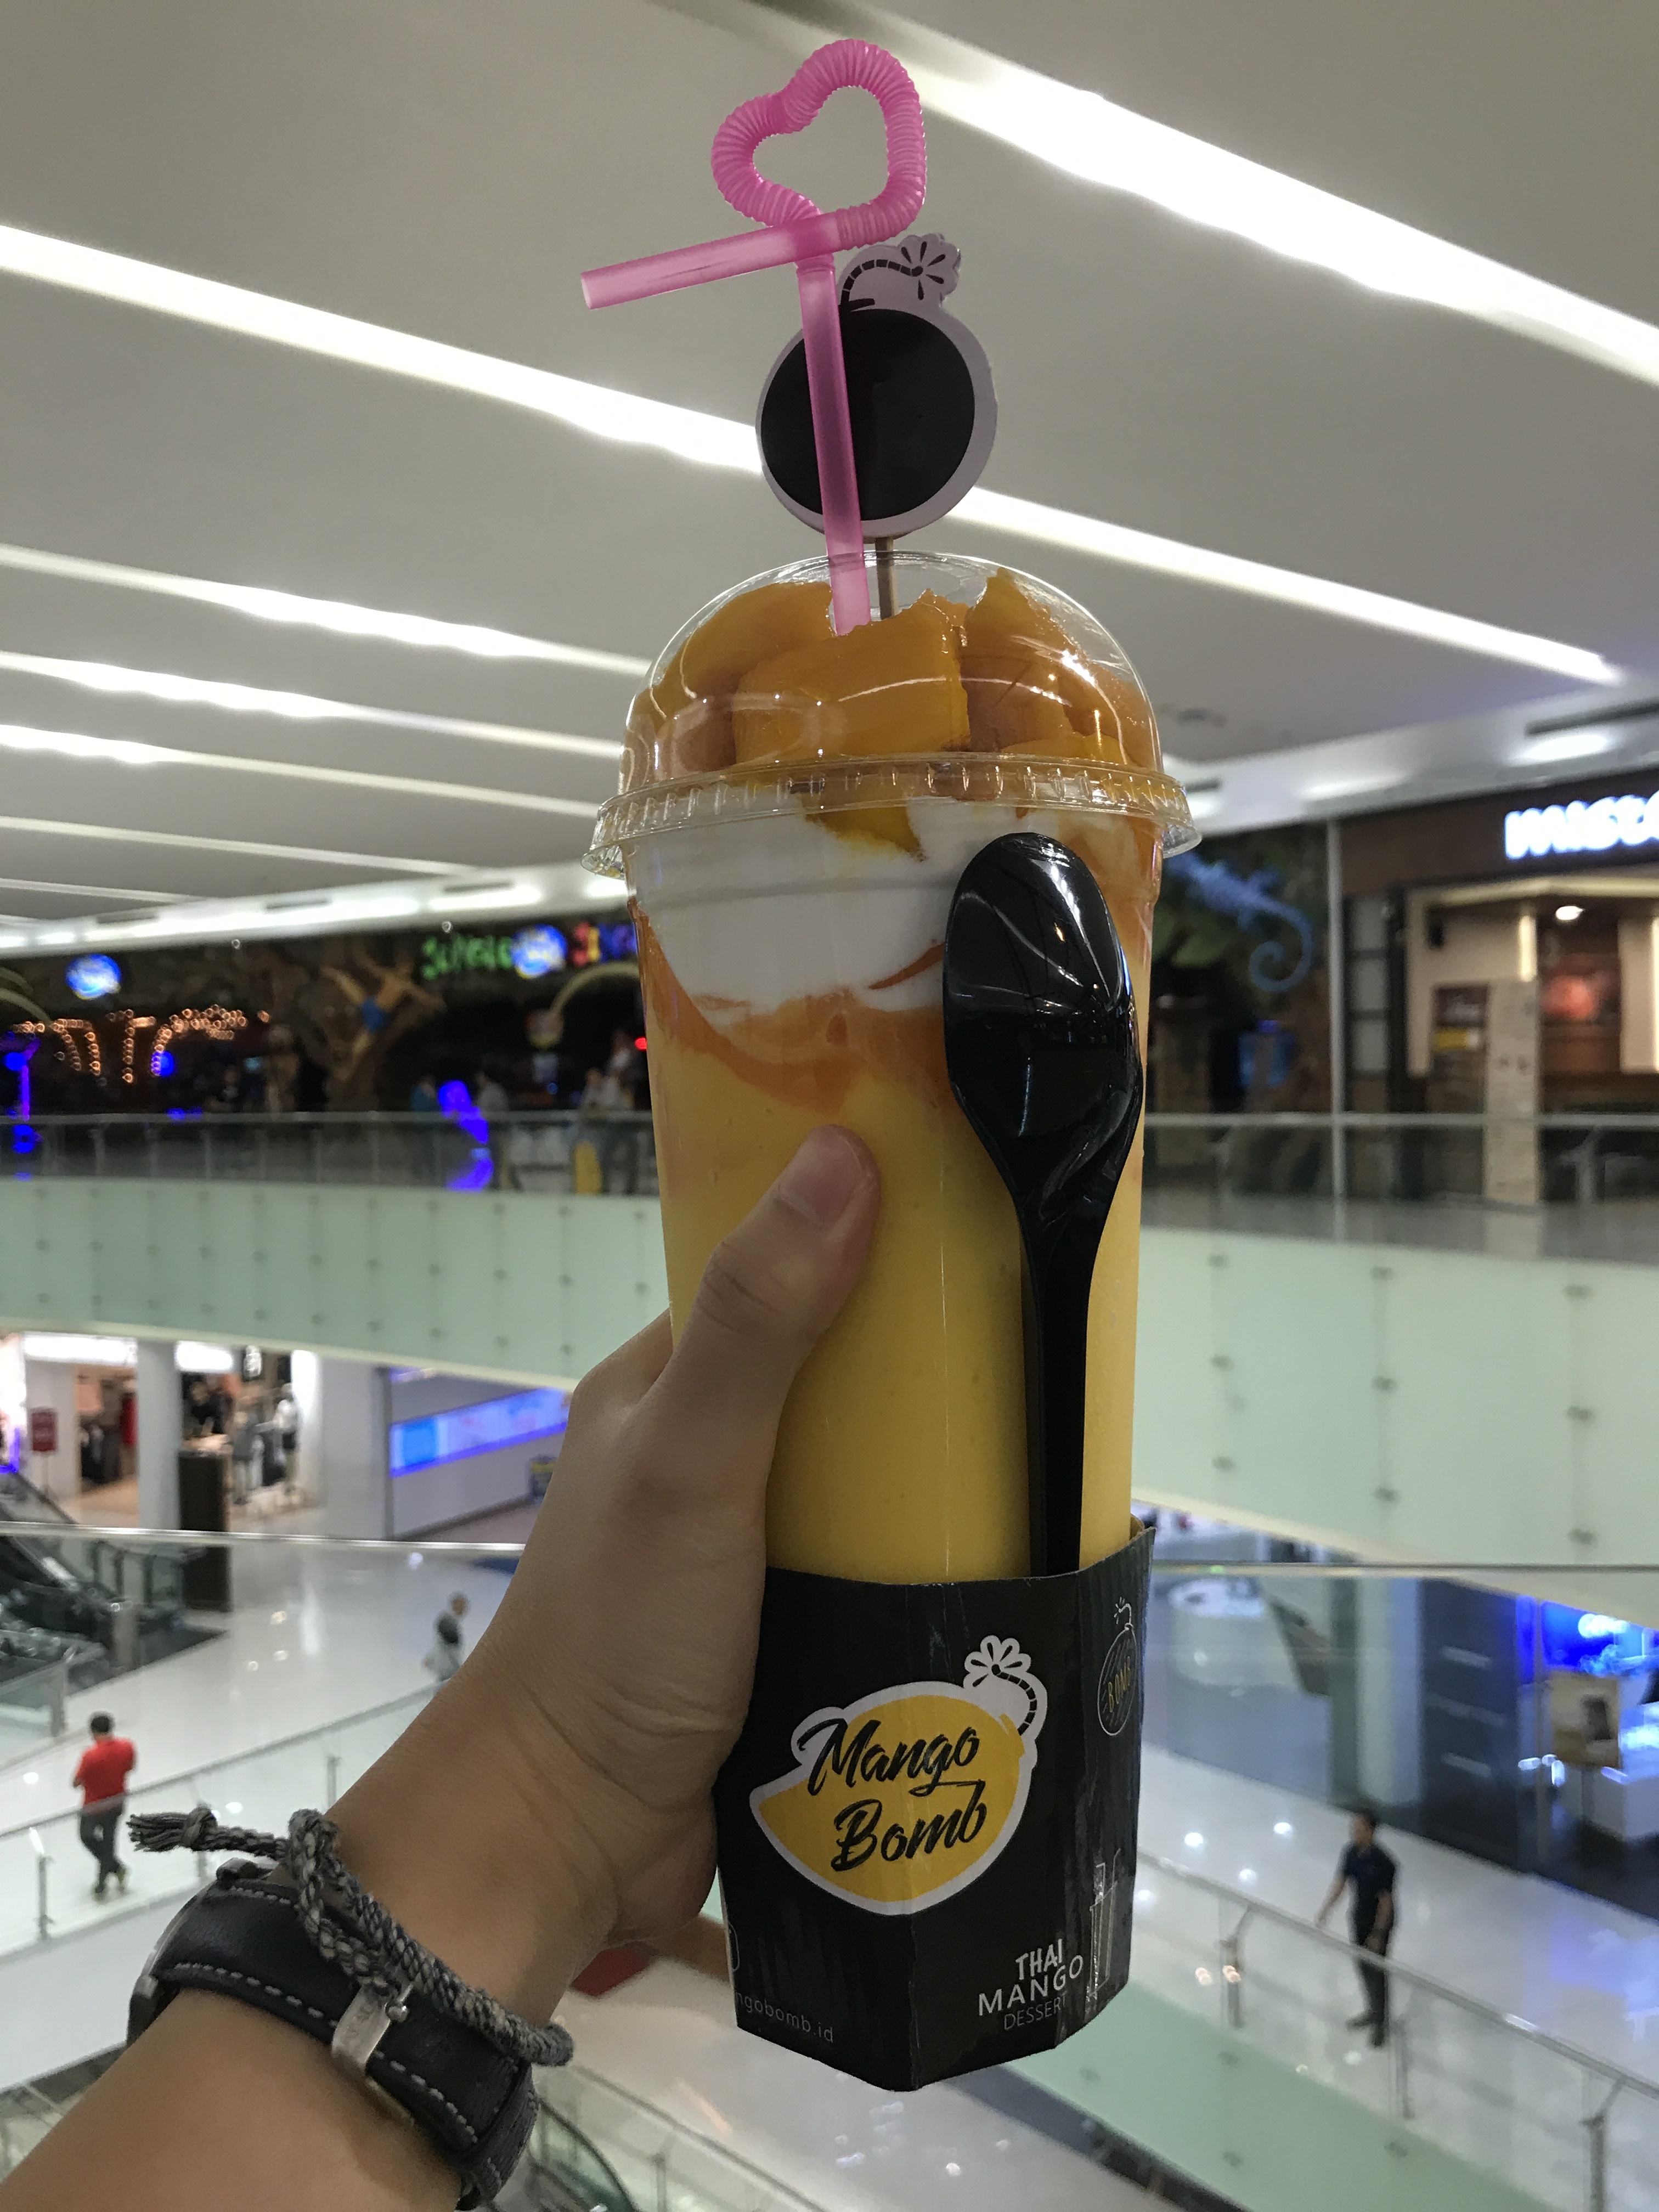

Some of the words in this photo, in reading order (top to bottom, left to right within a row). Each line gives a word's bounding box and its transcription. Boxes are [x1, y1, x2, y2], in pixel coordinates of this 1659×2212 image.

[797, 1718, 980, 1797] Mango
[831, 1779, 987, 1871] Bomb
[979, 1955, 1084, 2016] MANGO
[1015, 1938, 1062, 1980] THAI
[1004, 1990, 1069, 2030] DESSERT
